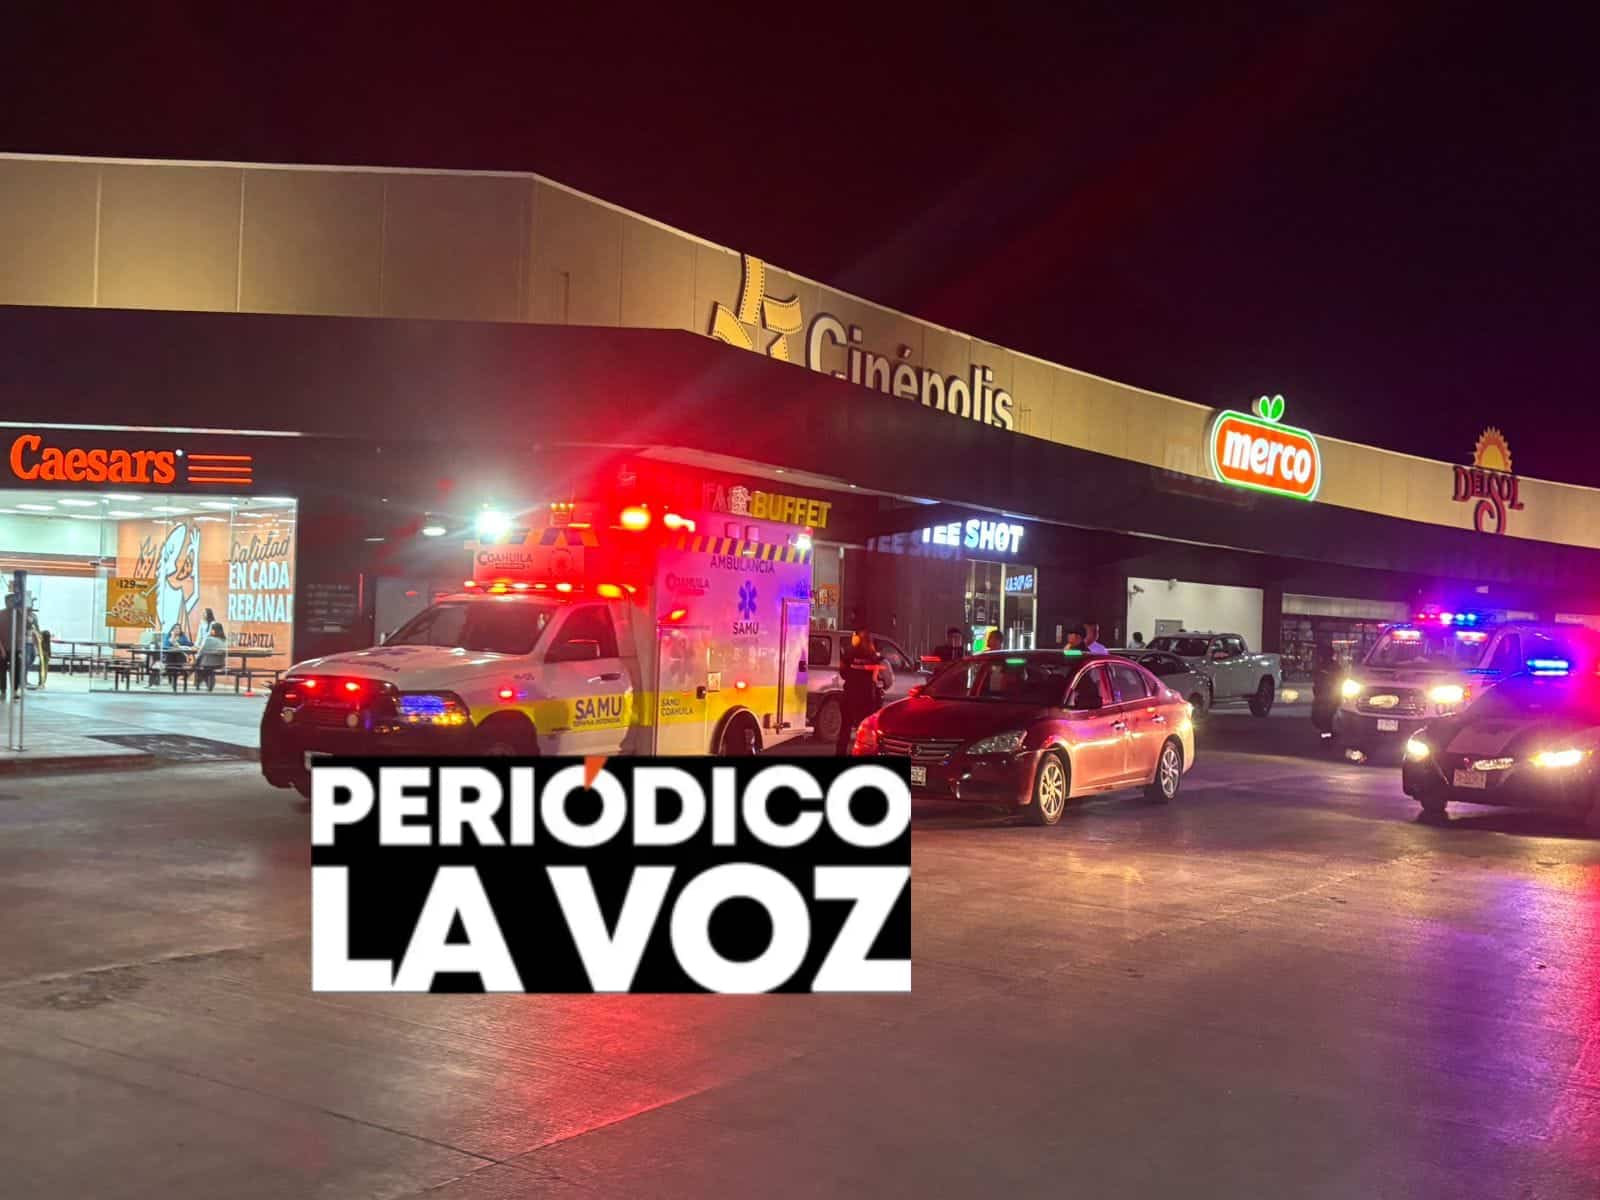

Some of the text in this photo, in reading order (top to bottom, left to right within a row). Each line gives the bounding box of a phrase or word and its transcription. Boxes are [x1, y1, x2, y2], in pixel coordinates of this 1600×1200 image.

[10, 434, 176, 485] Caesars
[1222, 430, 1312, 484] merco
[751, 490, 832, 528] BUFFET
[965, 518, 1024, 553] SHOT
[228, 561, 290, 590] EN CADA
[710, 554, 775, 573] AMBULANCIA
[732, 621, 759, 635] SAMU
[575, 695, 623, 720] SAMU
